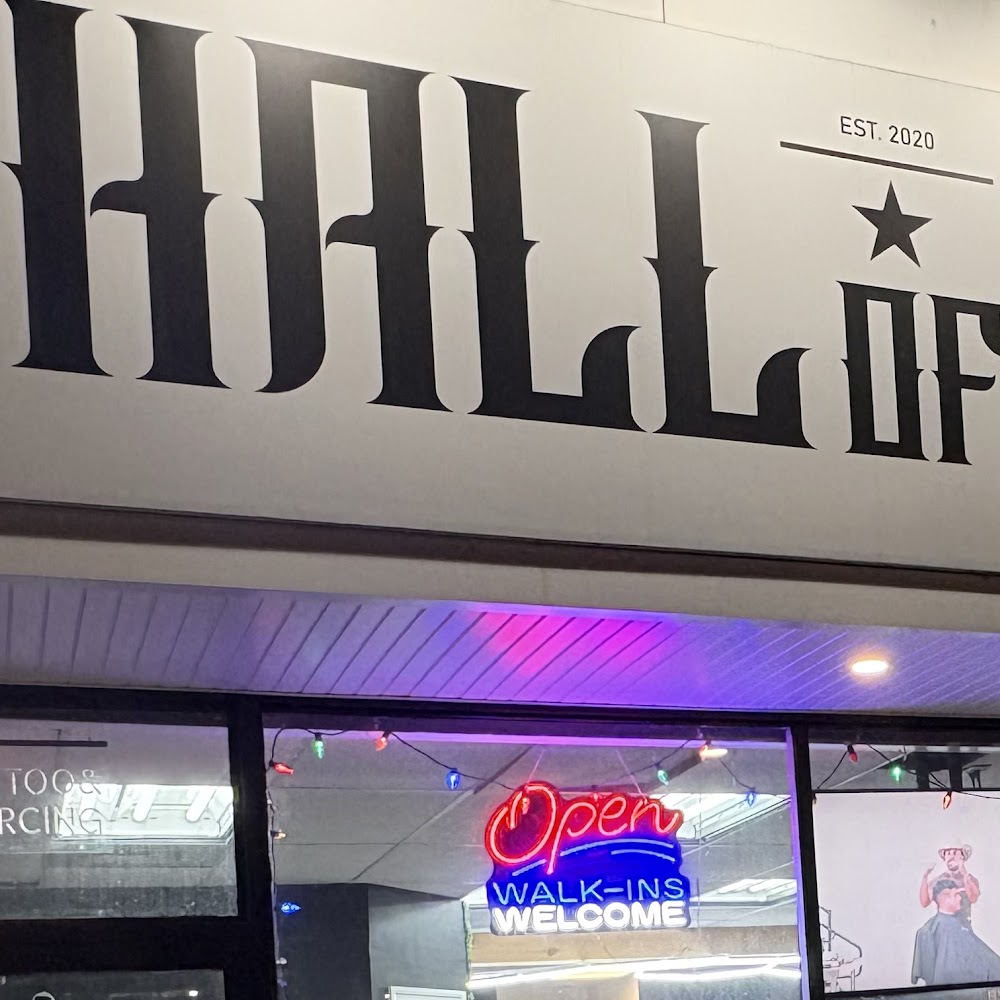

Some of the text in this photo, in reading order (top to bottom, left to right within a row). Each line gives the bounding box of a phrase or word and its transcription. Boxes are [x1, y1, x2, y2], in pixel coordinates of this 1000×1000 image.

[840, 115, 934, 150] EST. 2020
[0, 0, 816, 449] HALL
[486, 782, 683, 875] Open
[492, 877, 685, 906] WALK-INS
[492, 901, 688, 934] WELCOME
